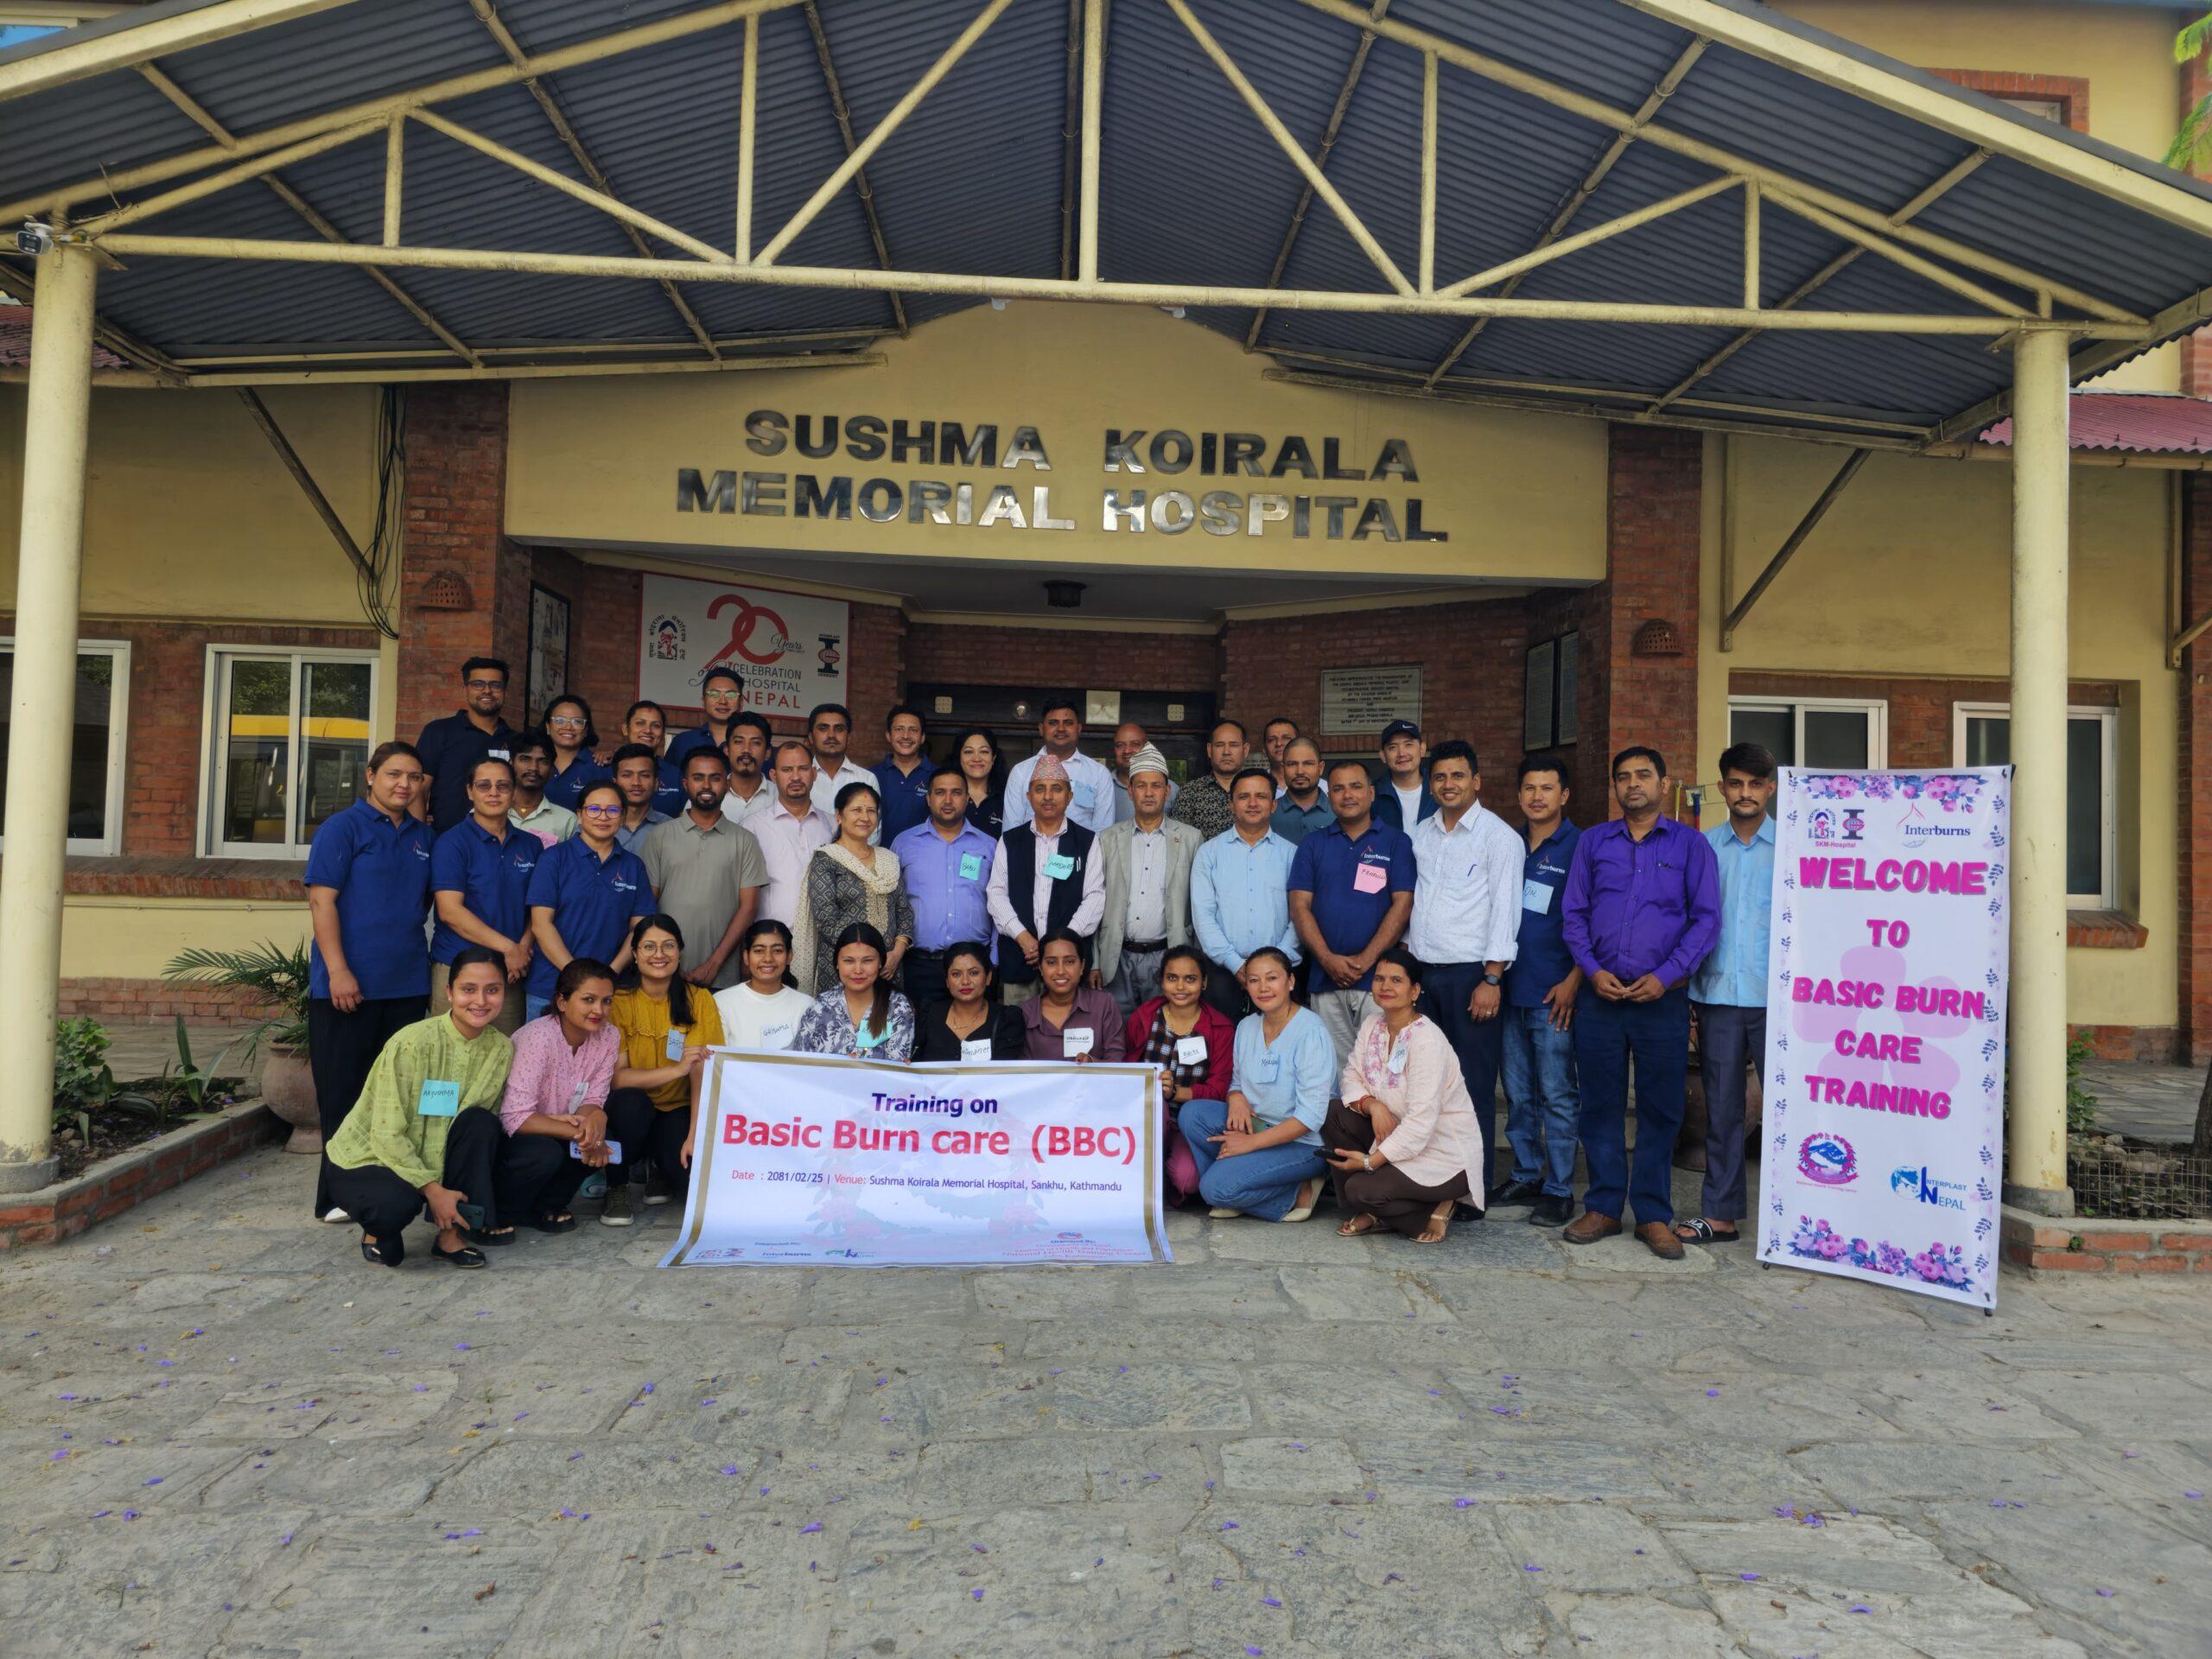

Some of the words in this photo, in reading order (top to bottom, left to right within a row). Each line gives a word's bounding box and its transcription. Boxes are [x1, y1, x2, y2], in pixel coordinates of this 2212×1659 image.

[745, 410, 1052, 471] SUSHMA
[1103, 429, 1420, 484] KOIRALA
[677, 467, 1075, 531] MEMORIAL
[1103, 488, 1448, 543] HOSPITAL
[733, 664, 802, 680] CELEBRATION
[743, 677, 801, 692] HOSPITAL
[742, 690, 801, 709] NEPAL
[1905, 824, 1971, 836] Interburns
[1799, 856, 1988, 895] WELCOME
[1866, 919, 1910, 949] TO
[1792, 976, 1885, 1008] BASIC
[1896, 985, 1986, 1020] BURN
[1834, 1029, 1923, 1064] CARE
[872, 1093, 963, 1117] Training
[969, 1097, 998, 1114] on
[1804, 1075, 1952, 1120] TRAINING
[723, 1114, 823, 1148] Basic
[833, 1120, 919, 1152] Burn
[931, 1130, 1010, 1155] care
[1032, 1125, 1136, 1165] (BBC)
[732, 1170, 755, 1180] Date
[767, 1171, 823, 1183] 2081/02/25
[835, 1174, 866, 1185] Venue:
[869, 1175, 905, 1186] Sushma
[907, 1177, 940, 1187] Koirala
[942, 1178, 985, 1189] Memorial
[988, 1179, 1027, 1191] Hospital,
[1031, 1180, 1067, 1192] Sankhu,
[1070, 1181, 1122, 1192] Kathmandu
